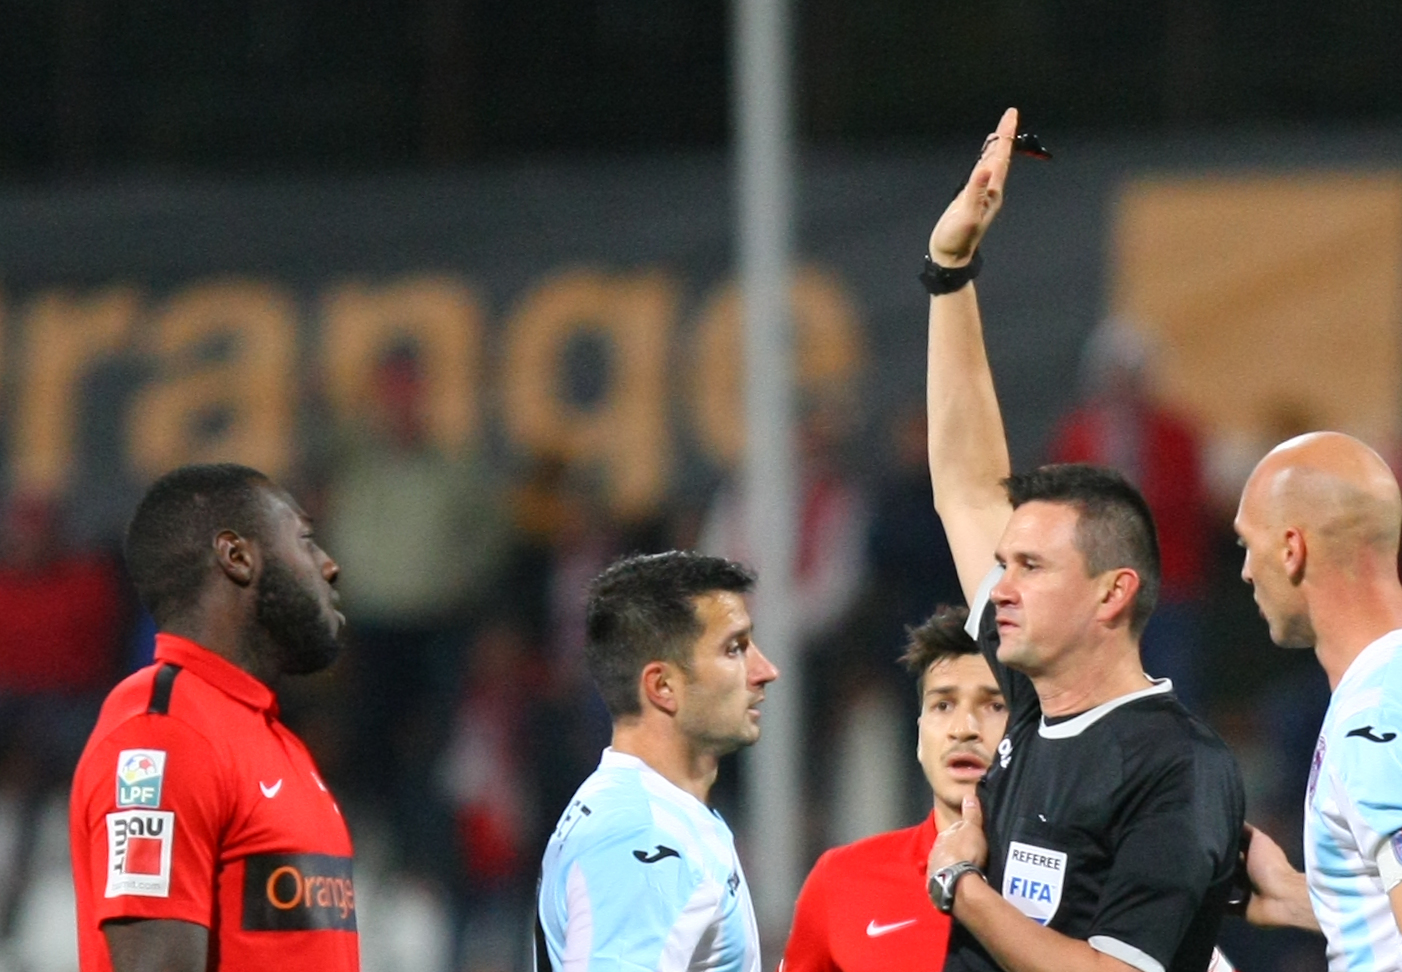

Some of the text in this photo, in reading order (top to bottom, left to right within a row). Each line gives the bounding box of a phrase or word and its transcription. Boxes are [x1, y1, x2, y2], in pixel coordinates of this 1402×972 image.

[0, 266, 868, 520] range
[120, 786, 155, 804] LPF
[1011, 848, 1062, 871] REFEREE
[266, 865, 355, 920] Orange
[1009, 875, 1053, 904] FIFA
